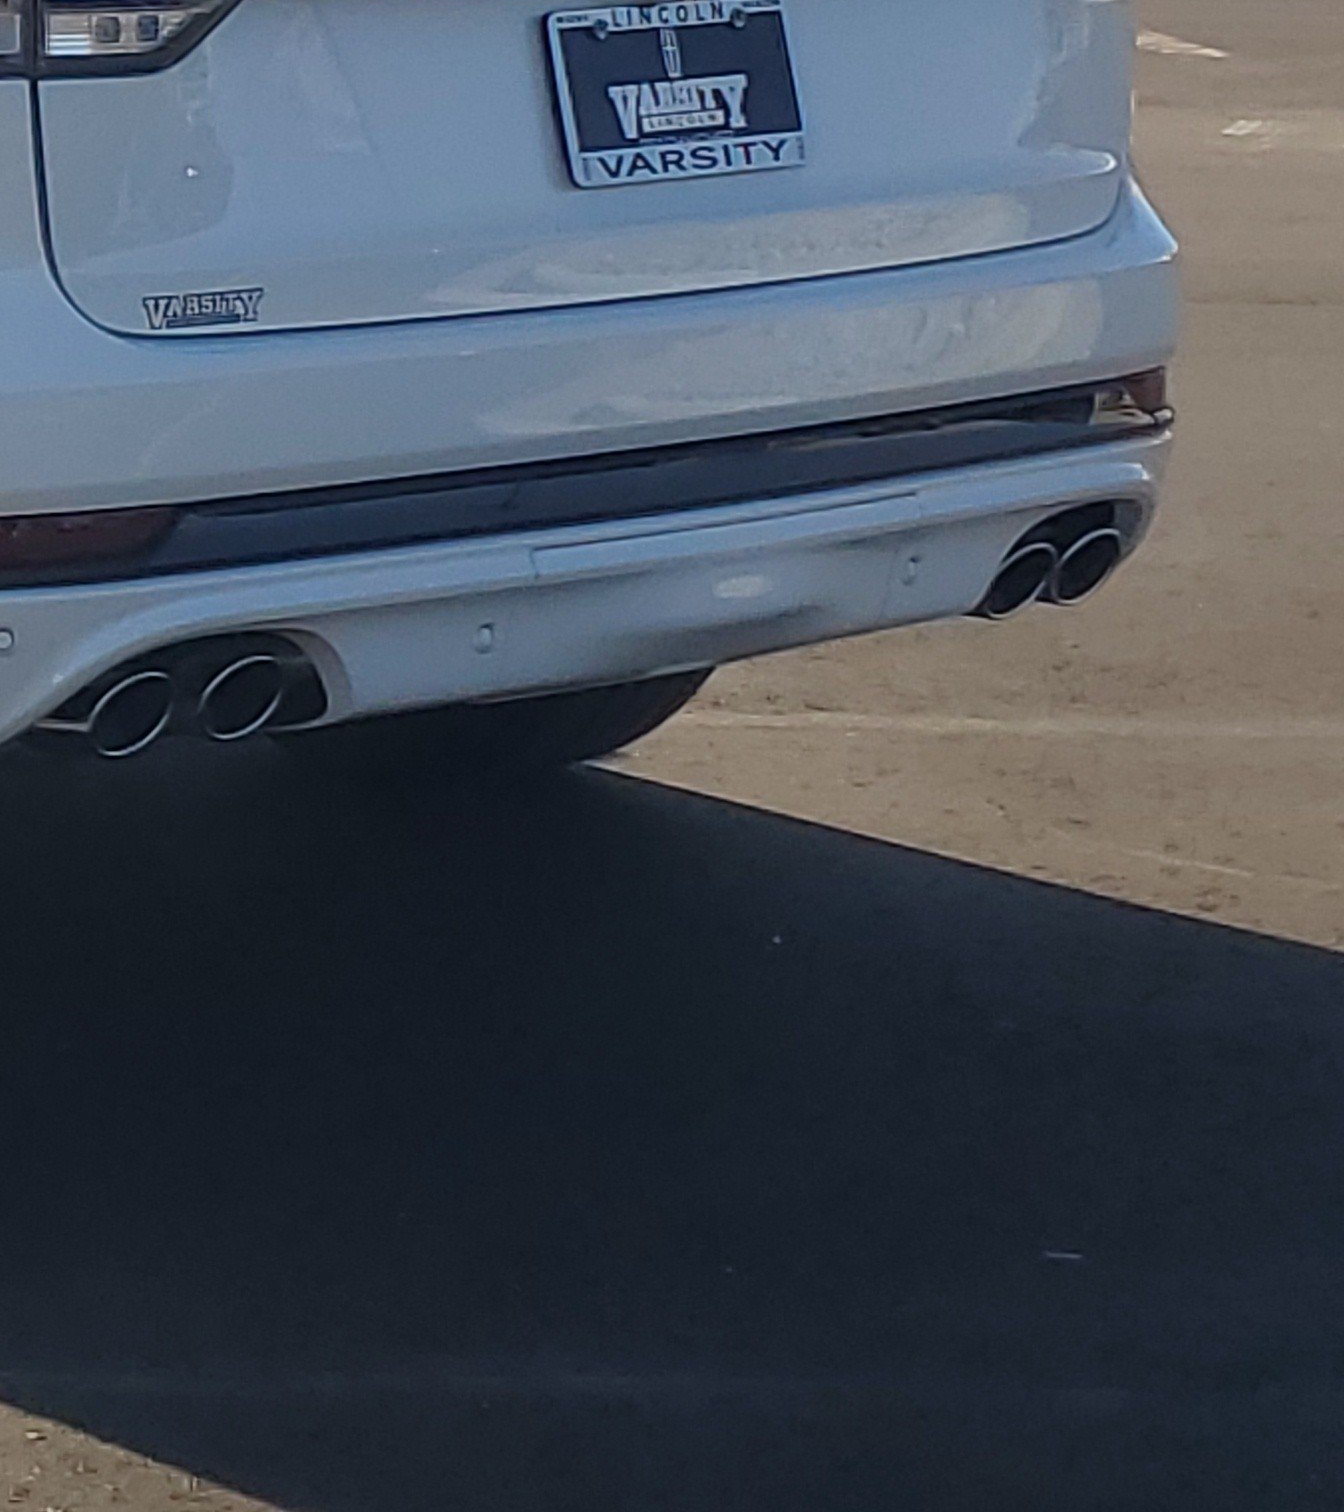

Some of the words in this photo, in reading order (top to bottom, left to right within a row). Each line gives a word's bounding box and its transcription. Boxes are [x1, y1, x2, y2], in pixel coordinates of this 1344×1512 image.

[613, 2, 724, 27] LINCOLN
[597, 140, 788, 178] VARSITY
[143, 287, 264, 329] VARSITY
